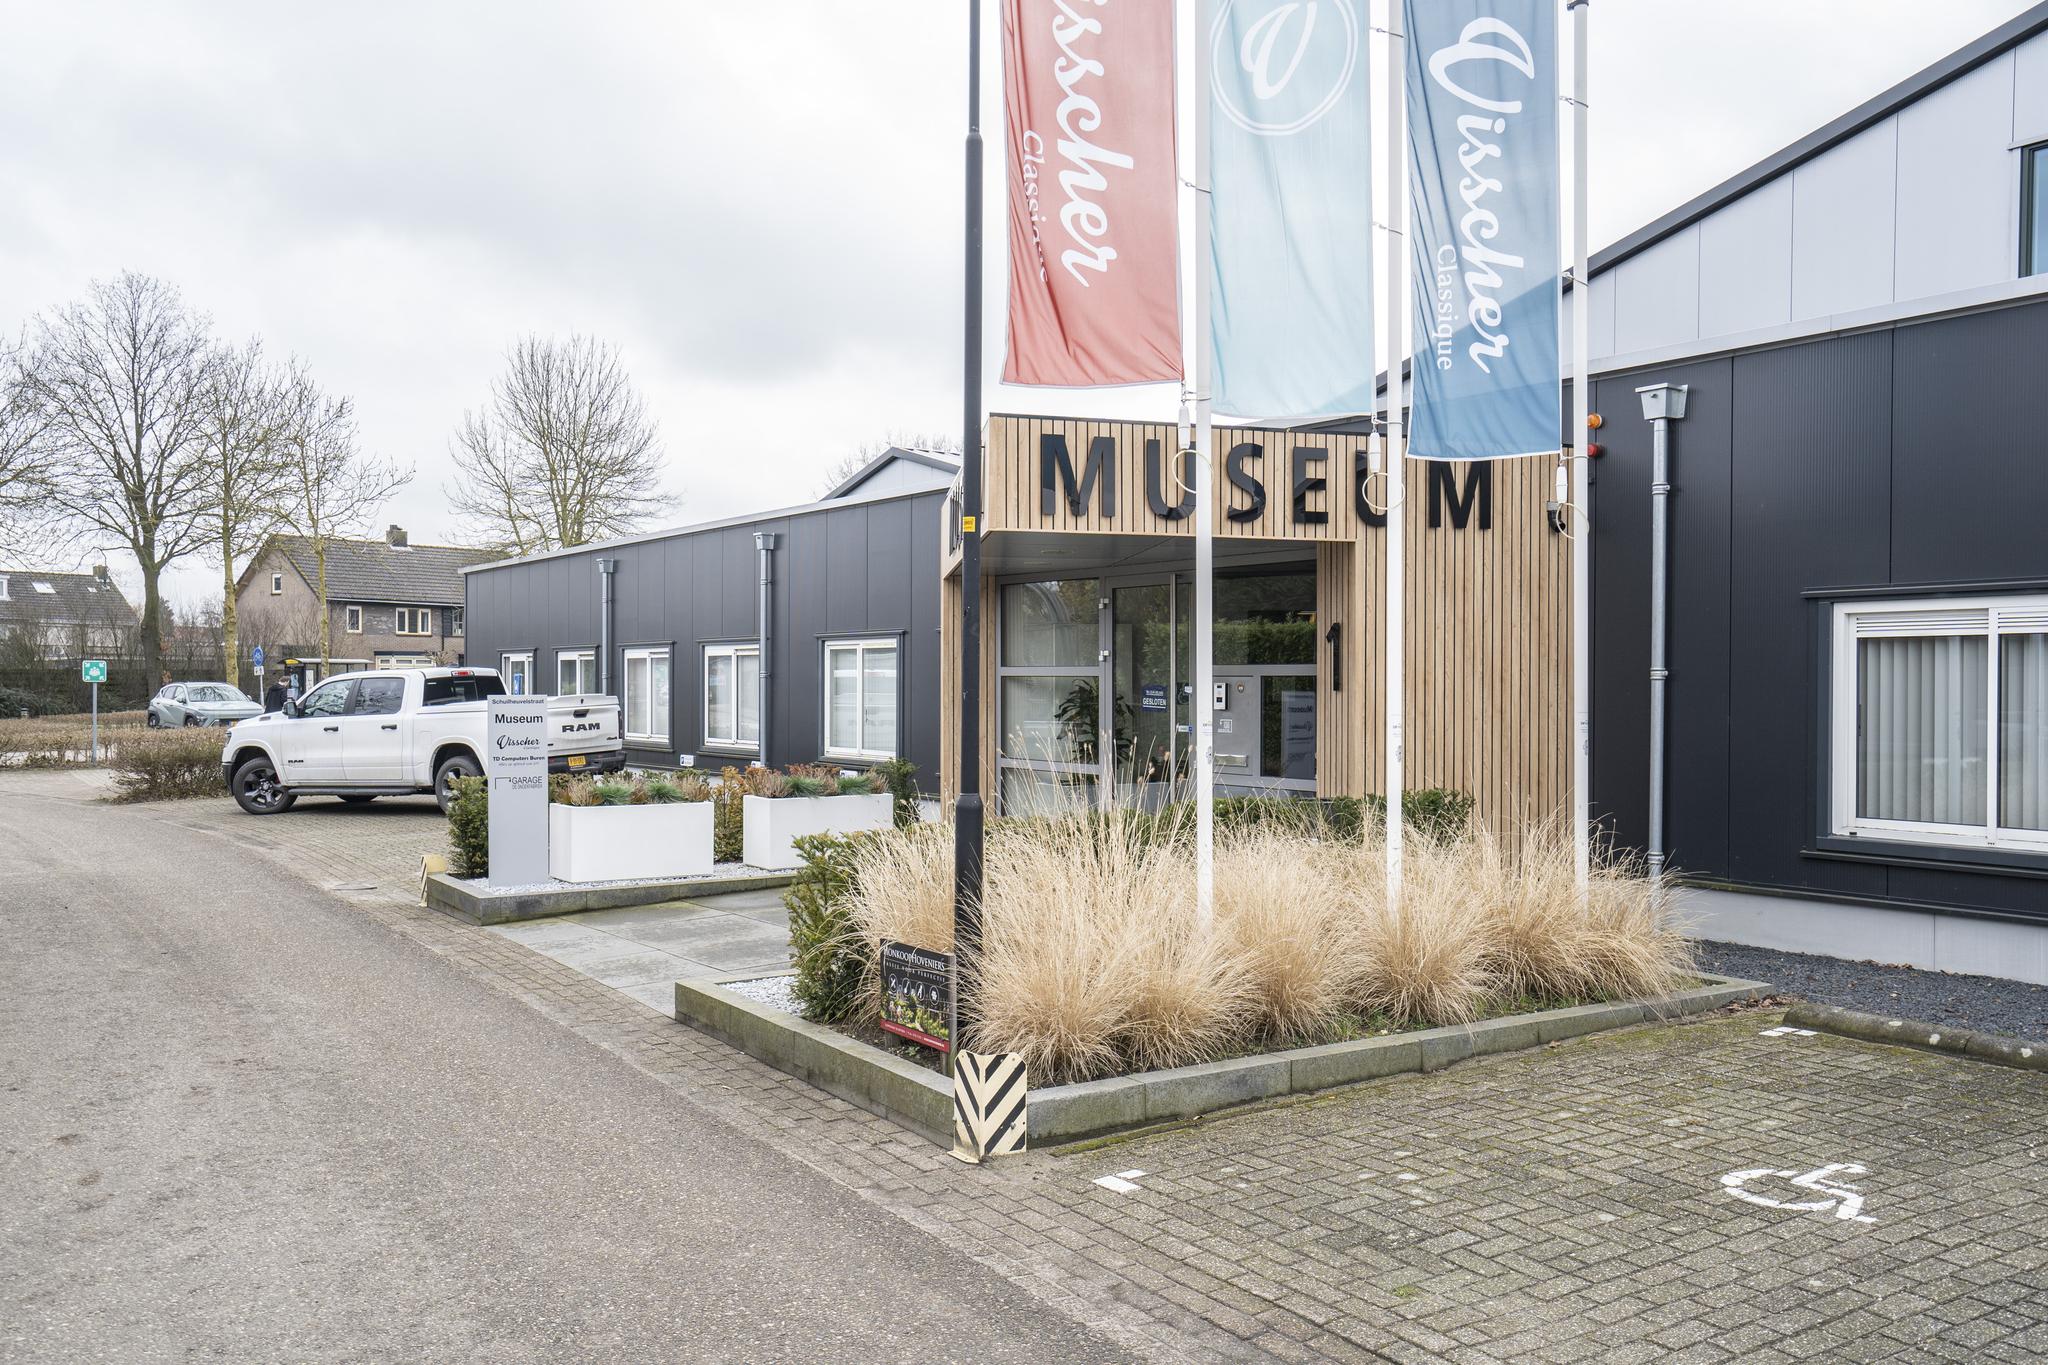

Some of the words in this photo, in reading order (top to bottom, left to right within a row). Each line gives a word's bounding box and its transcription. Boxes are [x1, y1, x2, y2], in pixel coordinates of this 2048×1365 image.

[1428, 16, 1535, 374] Visscher
[1023, 129, 1047, 283] Classi
[1432, 243, 1458, 371] Classique
[1040, 433, 1492, 530] MUSEUM
[1142, 697, 1167, 706] GESLOTEN
[494, 713, 544, 724] Museum
[561, 722, 601, 733] RAM
[496, 734, 541, 750] Visscher
[511, 776, 543, 785] GARAGE
